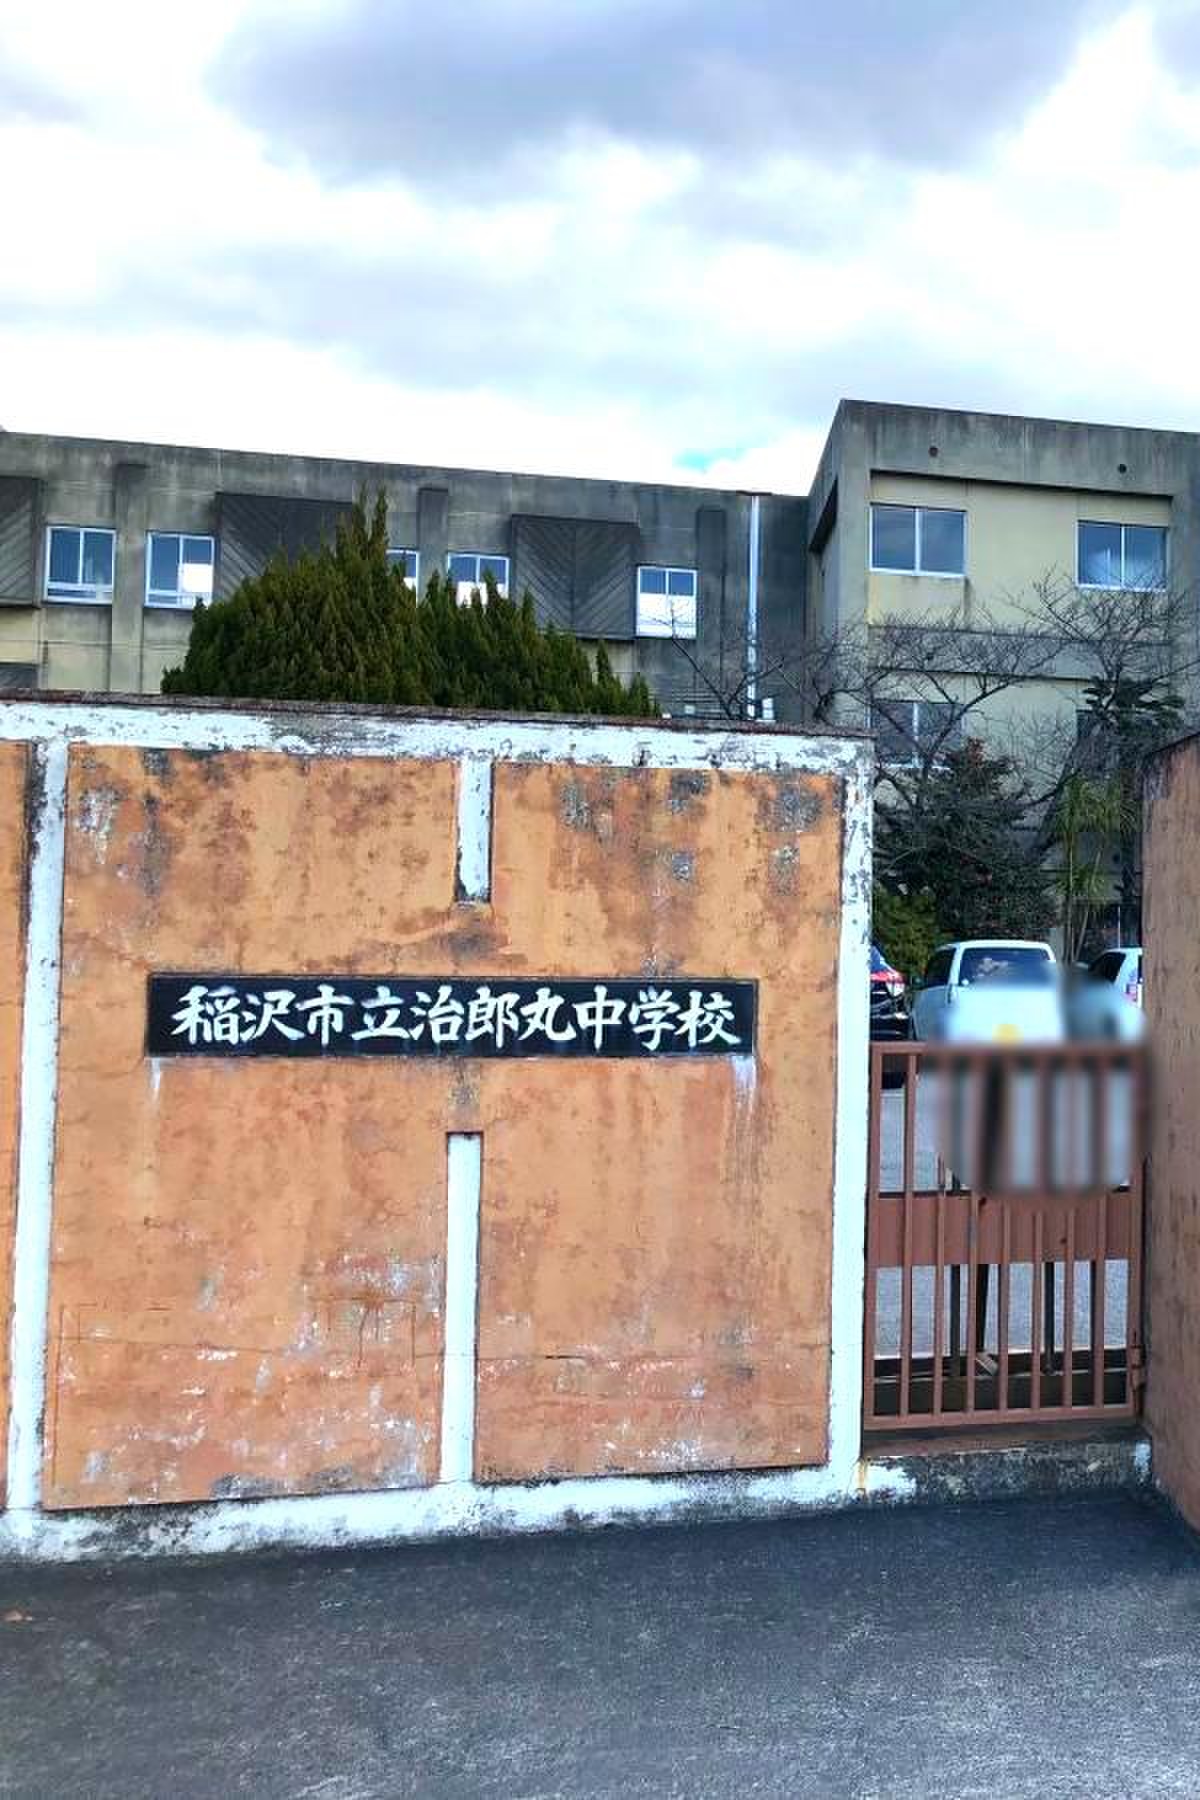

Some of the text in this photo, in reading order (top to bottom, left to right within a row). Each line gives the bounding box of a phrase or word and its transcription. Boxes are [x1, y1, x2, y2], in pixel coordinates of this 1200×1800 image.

[171, 984, 740, 1050] 稲沢市立治郎丸中学校
